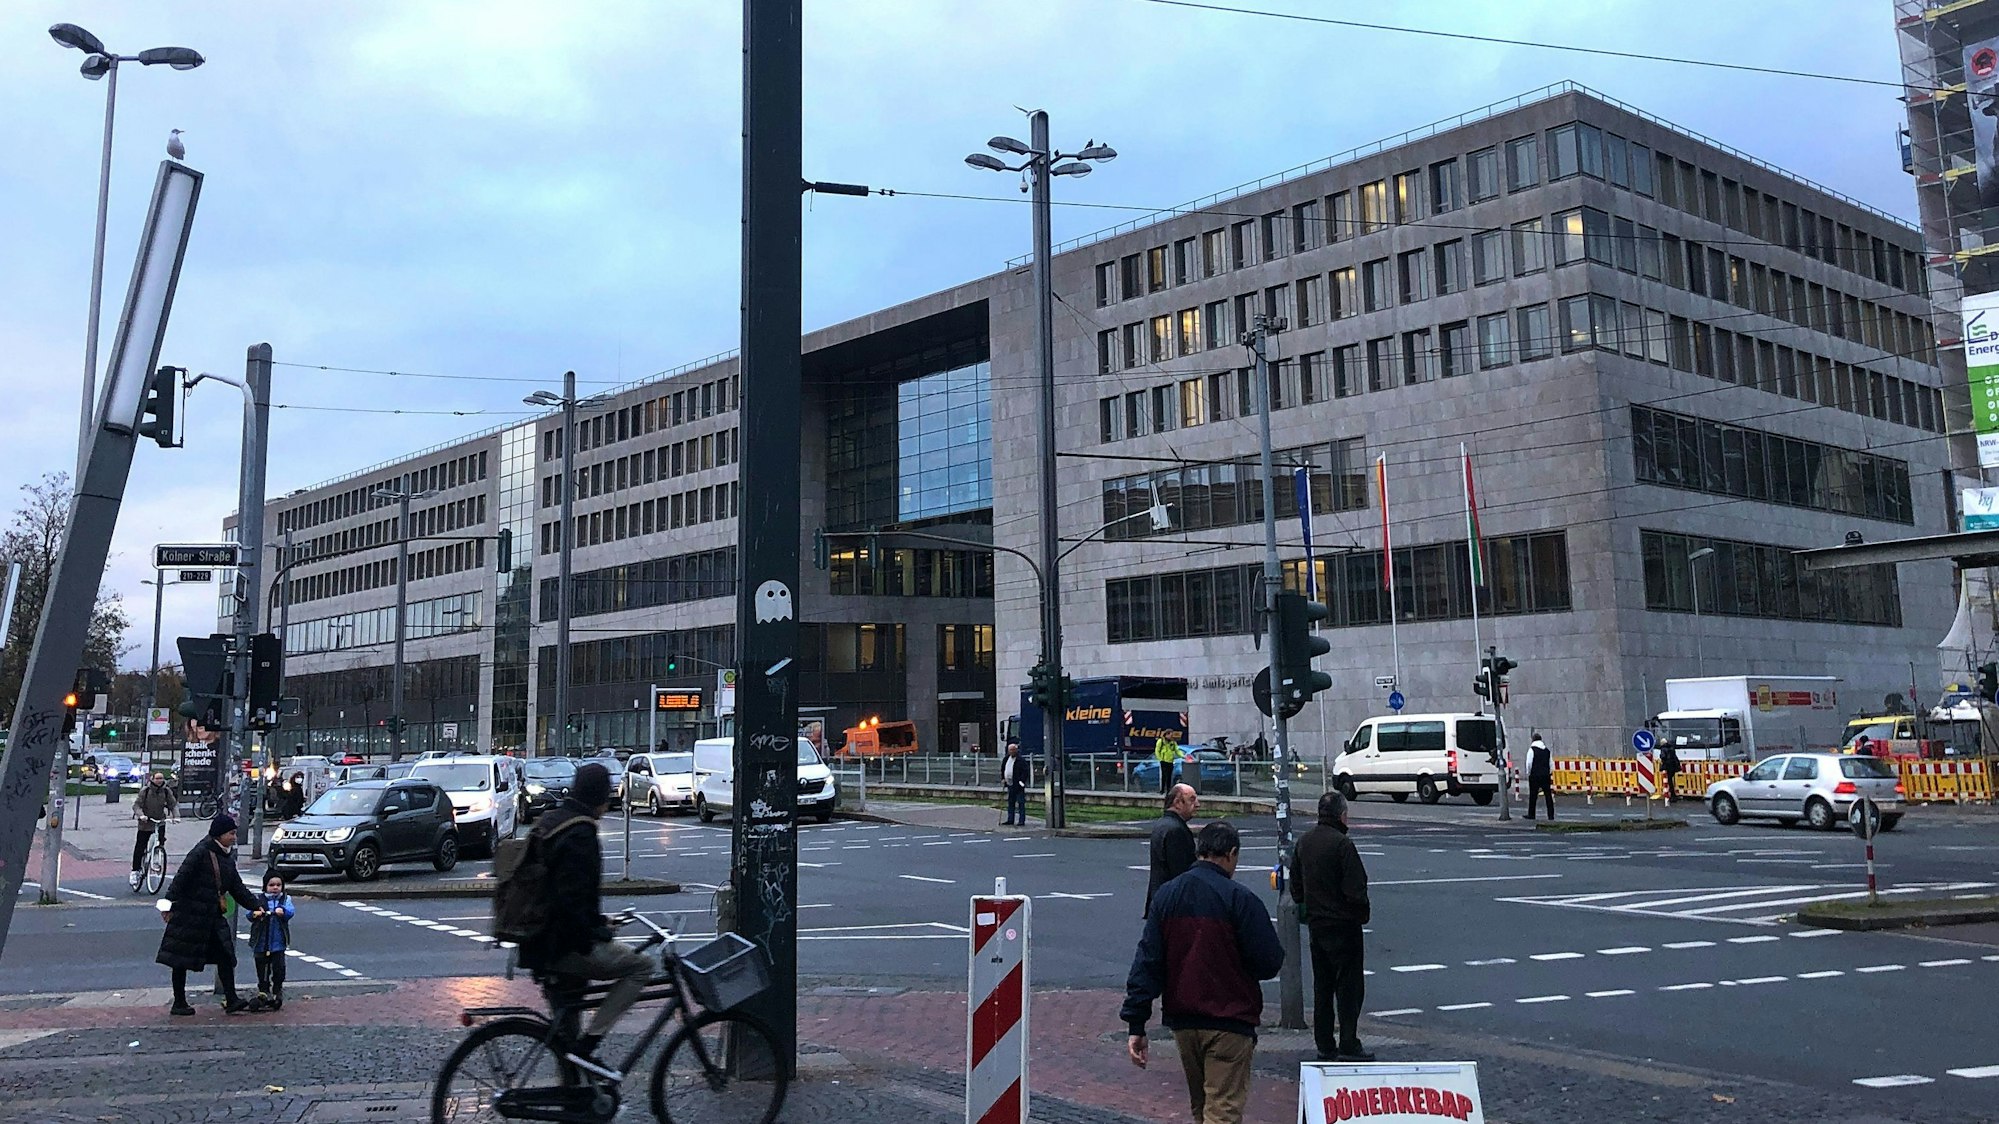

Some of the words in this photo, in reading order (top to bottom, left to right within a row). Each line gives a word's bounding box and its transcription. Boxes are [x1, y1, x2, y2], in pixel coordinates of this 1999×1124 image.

[162, 549, 194, 562] Kölner
[199, 550, 231, 562] Straße
[1202, 675, 1254, 690] Amtsgeric
[1066, 705, 1111, 720] kleine
[1129, 726, 1183, 738] kleie
[185, 740, 208, 749] Musik
[185, 749, 216, 757] schenkt
[184, 757, 211, 765] Freude
[1323, 1087, 1473, 1124] DÖNERKEBAP
